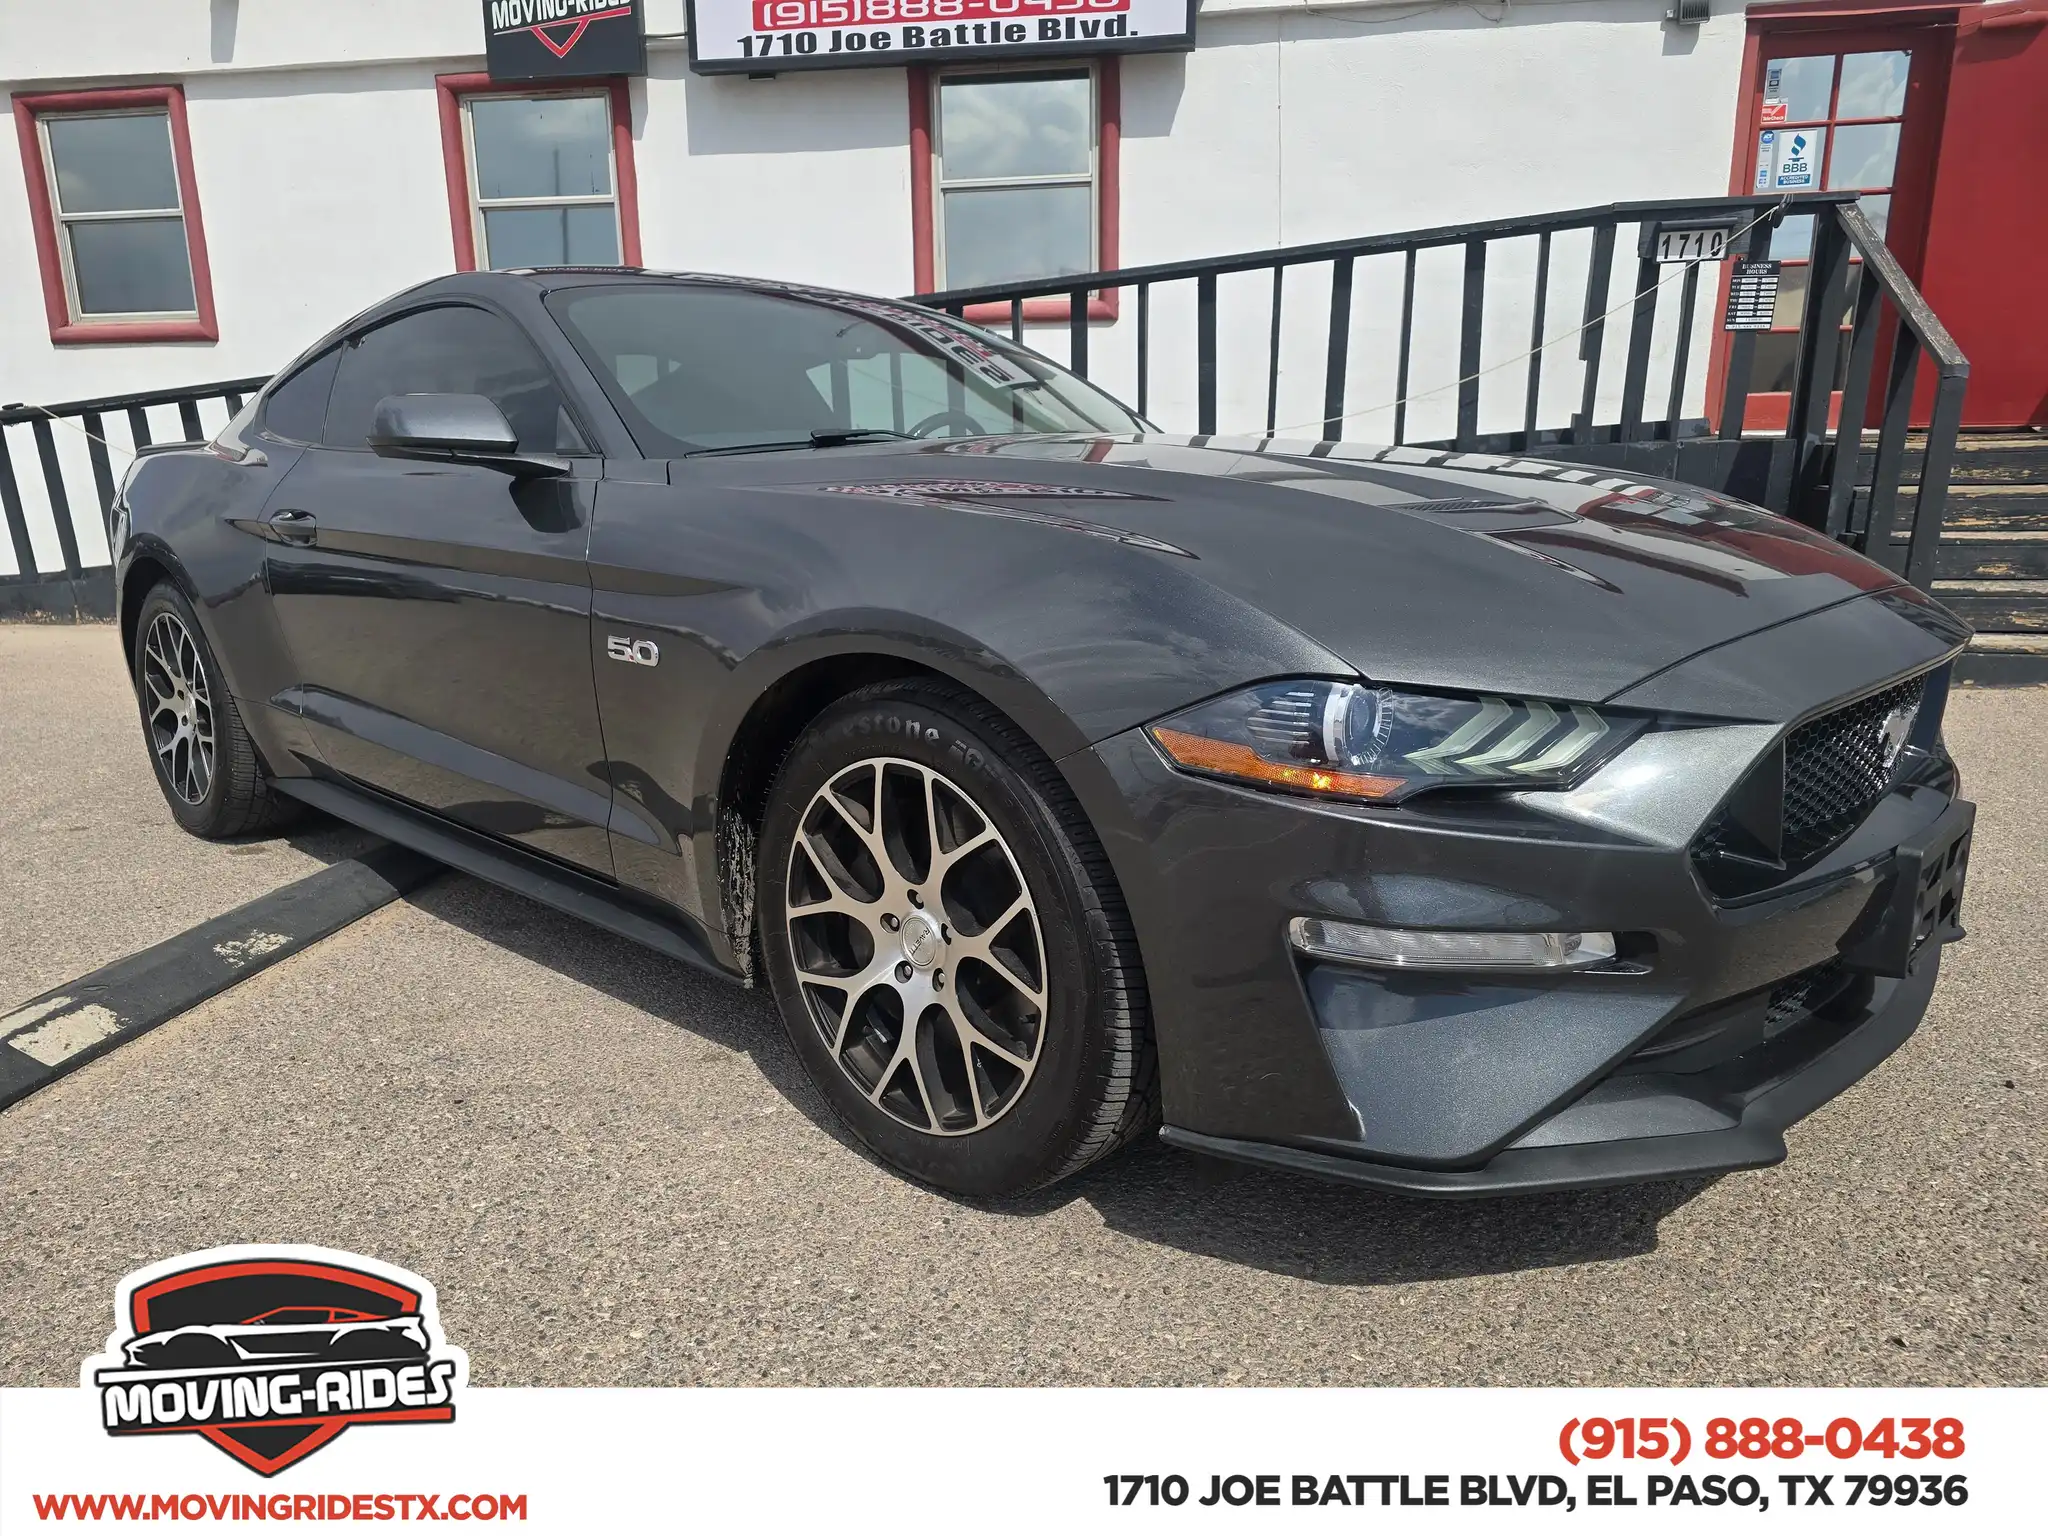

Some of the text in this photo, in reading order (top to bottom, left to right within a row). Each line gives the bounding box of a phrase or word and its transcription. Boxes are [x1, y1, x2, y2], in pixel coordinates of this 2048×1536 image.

[491, 0, 631, 29] MOVING-
[737, 14, 1138, 58] 1710 Joe Battle Blvd.
[1783, 163, 1808, 173] BBB
[1662, 232, 1722, 259] 1710
